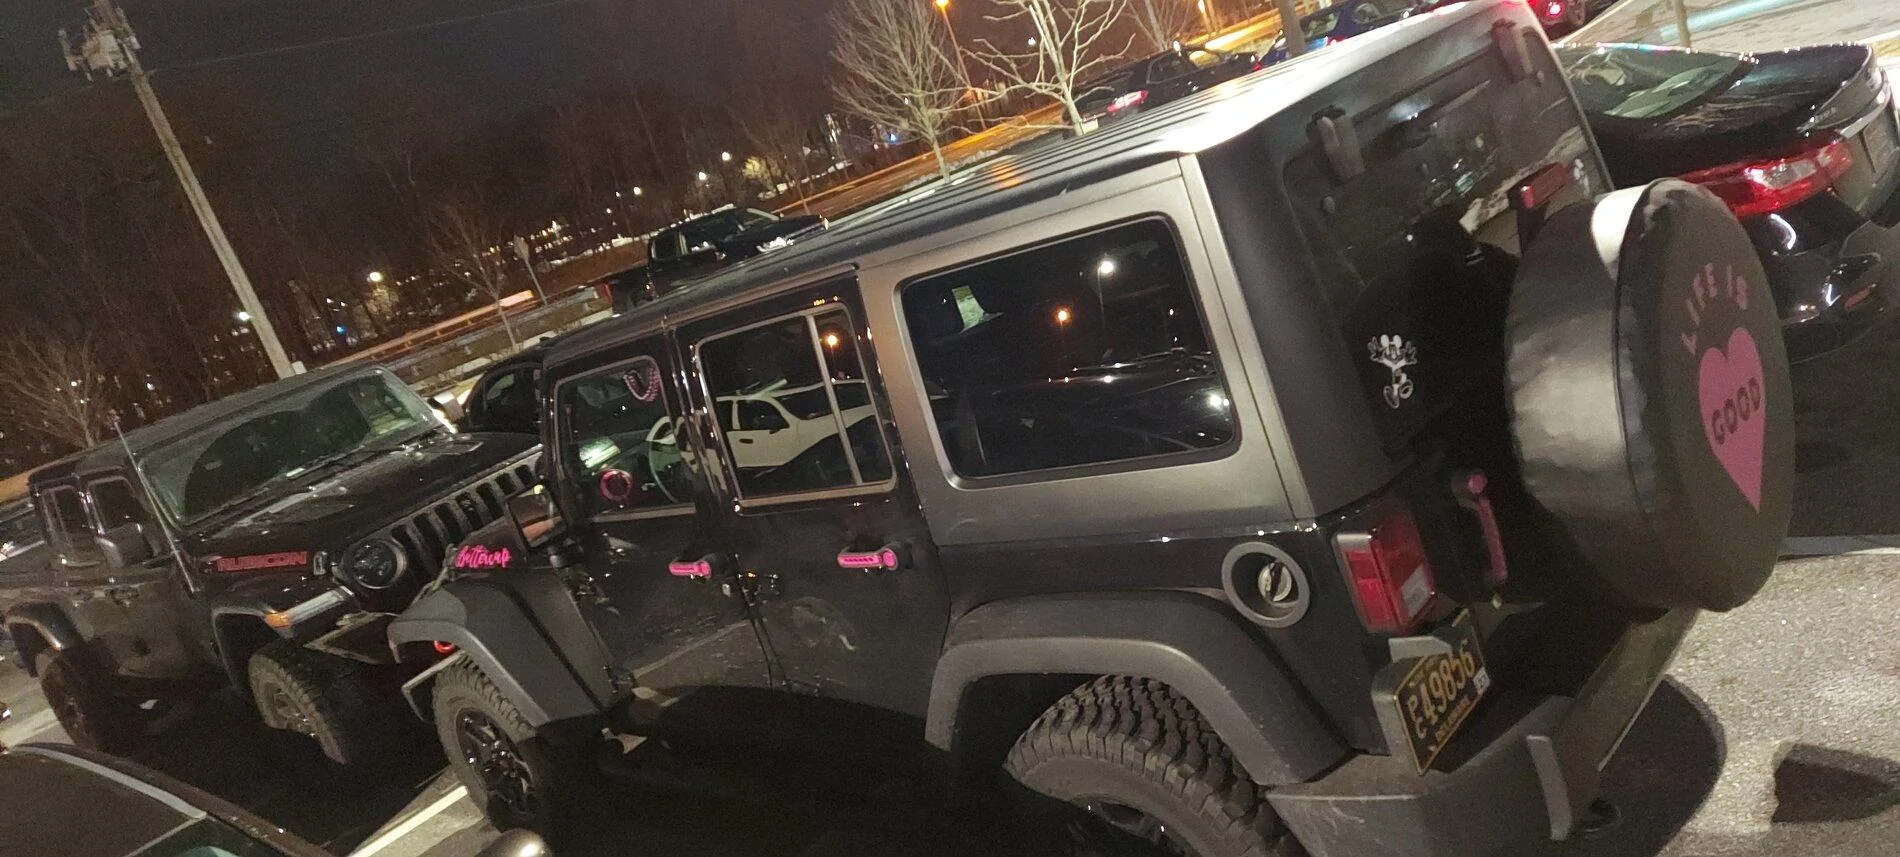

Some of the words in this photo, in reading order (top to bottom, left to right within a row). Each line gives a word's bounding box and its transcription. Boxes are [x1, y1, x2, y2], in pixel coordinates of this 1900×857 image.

[1681, 262, 1718, 354] LIFE
[1726, 262, 1748, 311] IS
[1711, 376, 1761, 445] GOOD
[217, 550, 308, 572] RUBICON
[1419, 637, 1476, 726] 49856
